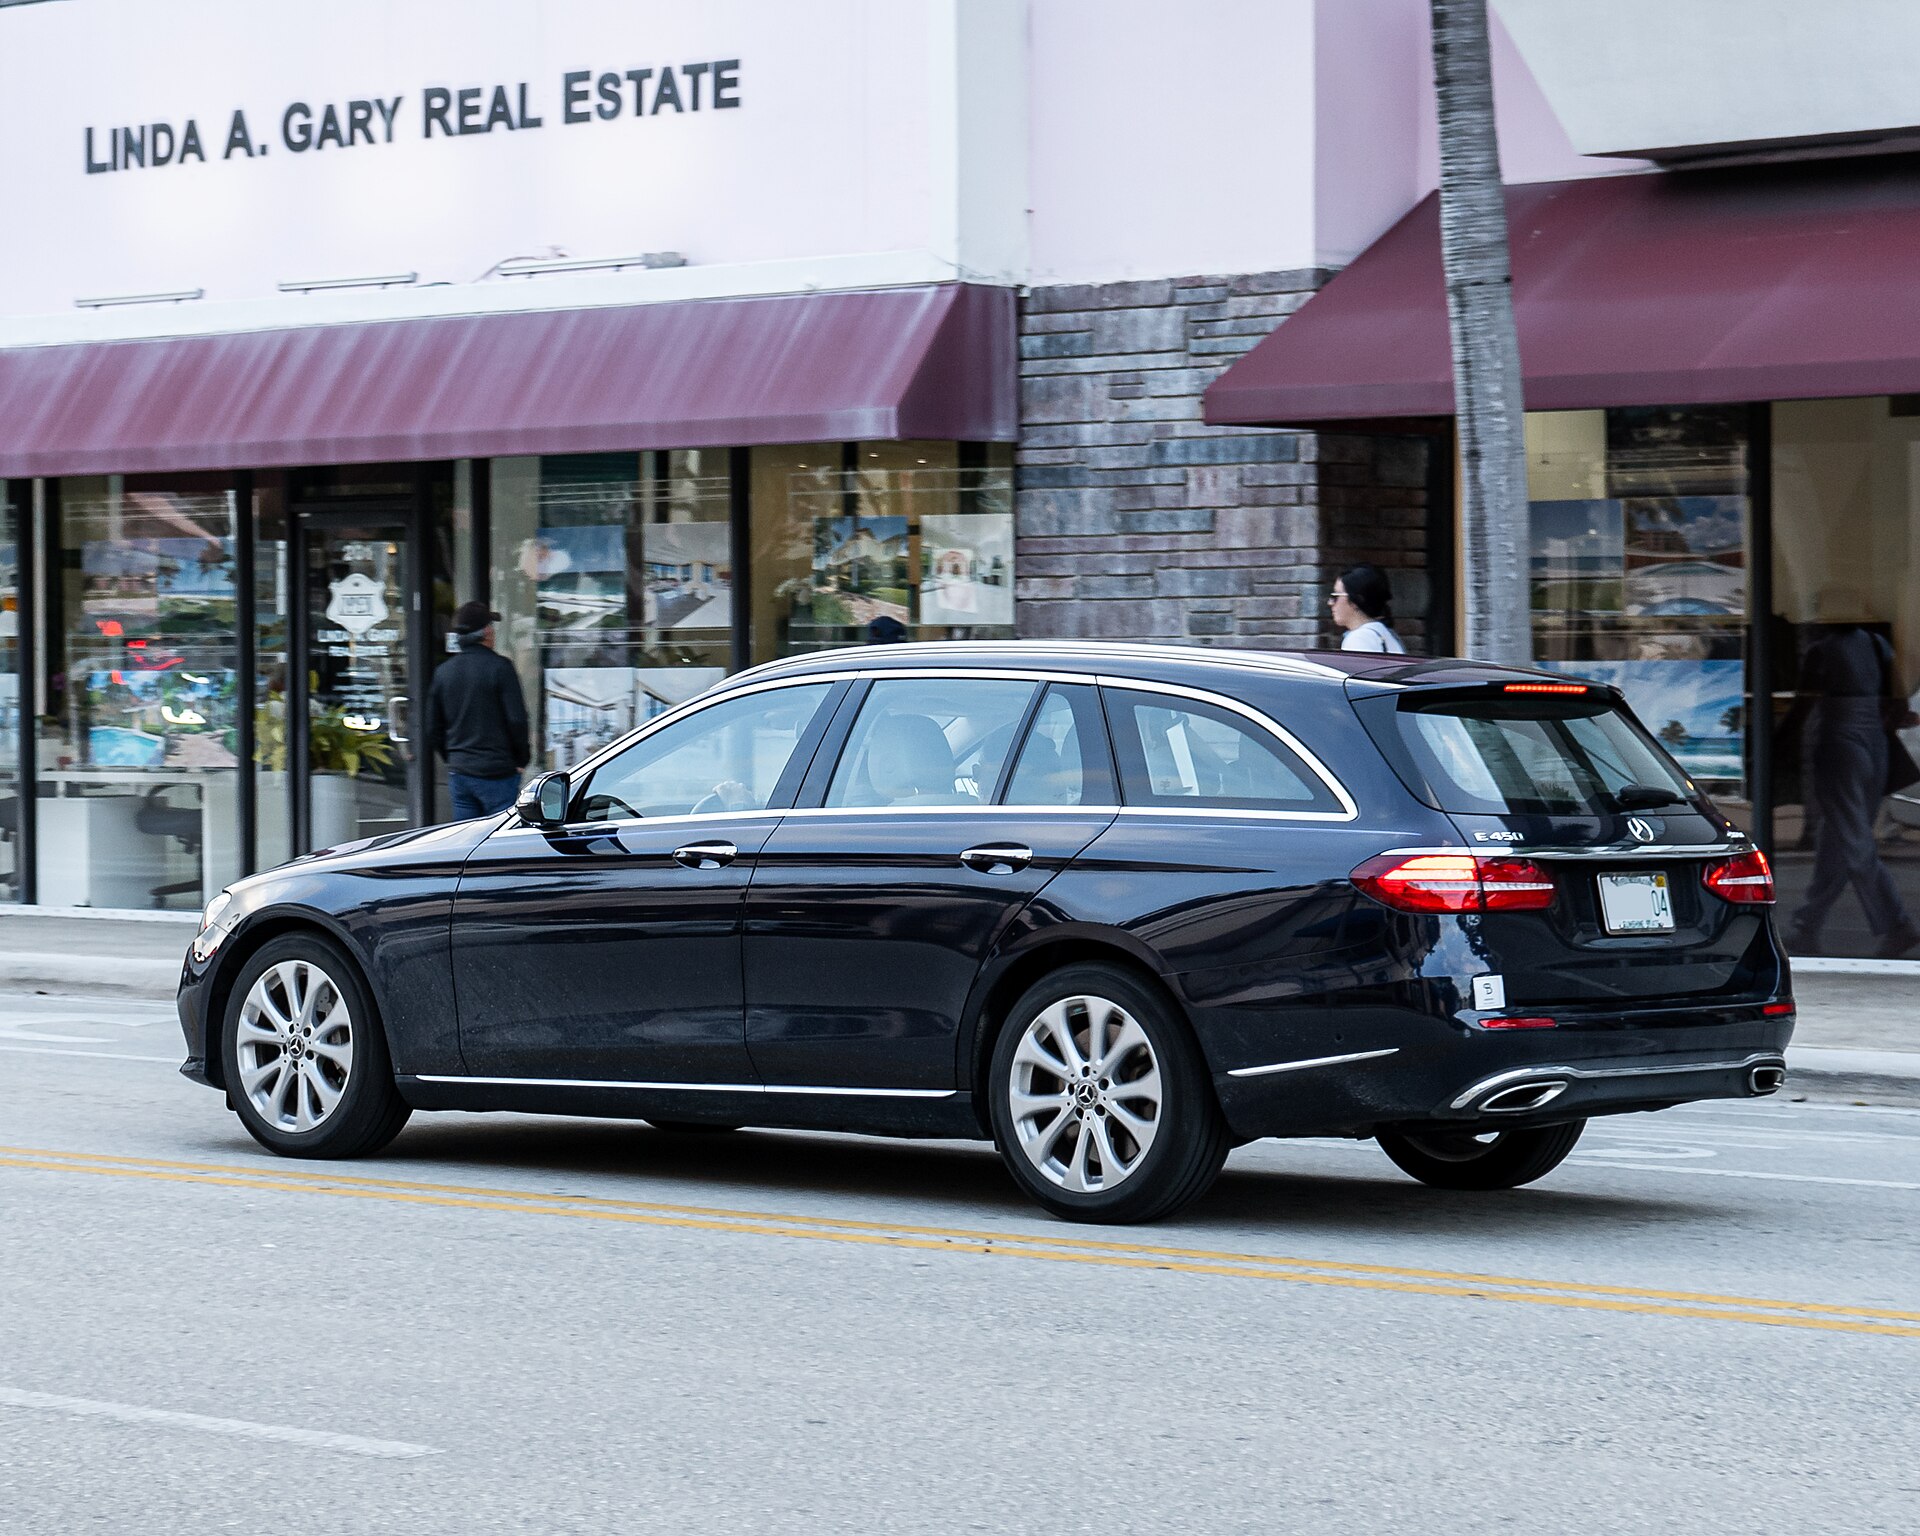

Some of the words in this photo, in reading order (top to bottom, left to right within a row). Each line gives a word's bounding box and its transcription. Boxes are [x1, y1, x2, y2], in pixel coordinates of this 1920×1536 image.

[85, 122, 205, 174] LINDA
[224, 110, 268, 159] A.
[281, 97, 403, 152] GARY
[422, 83, 543, 138] REAL
[563, 59, 741, 124] ESTATE
